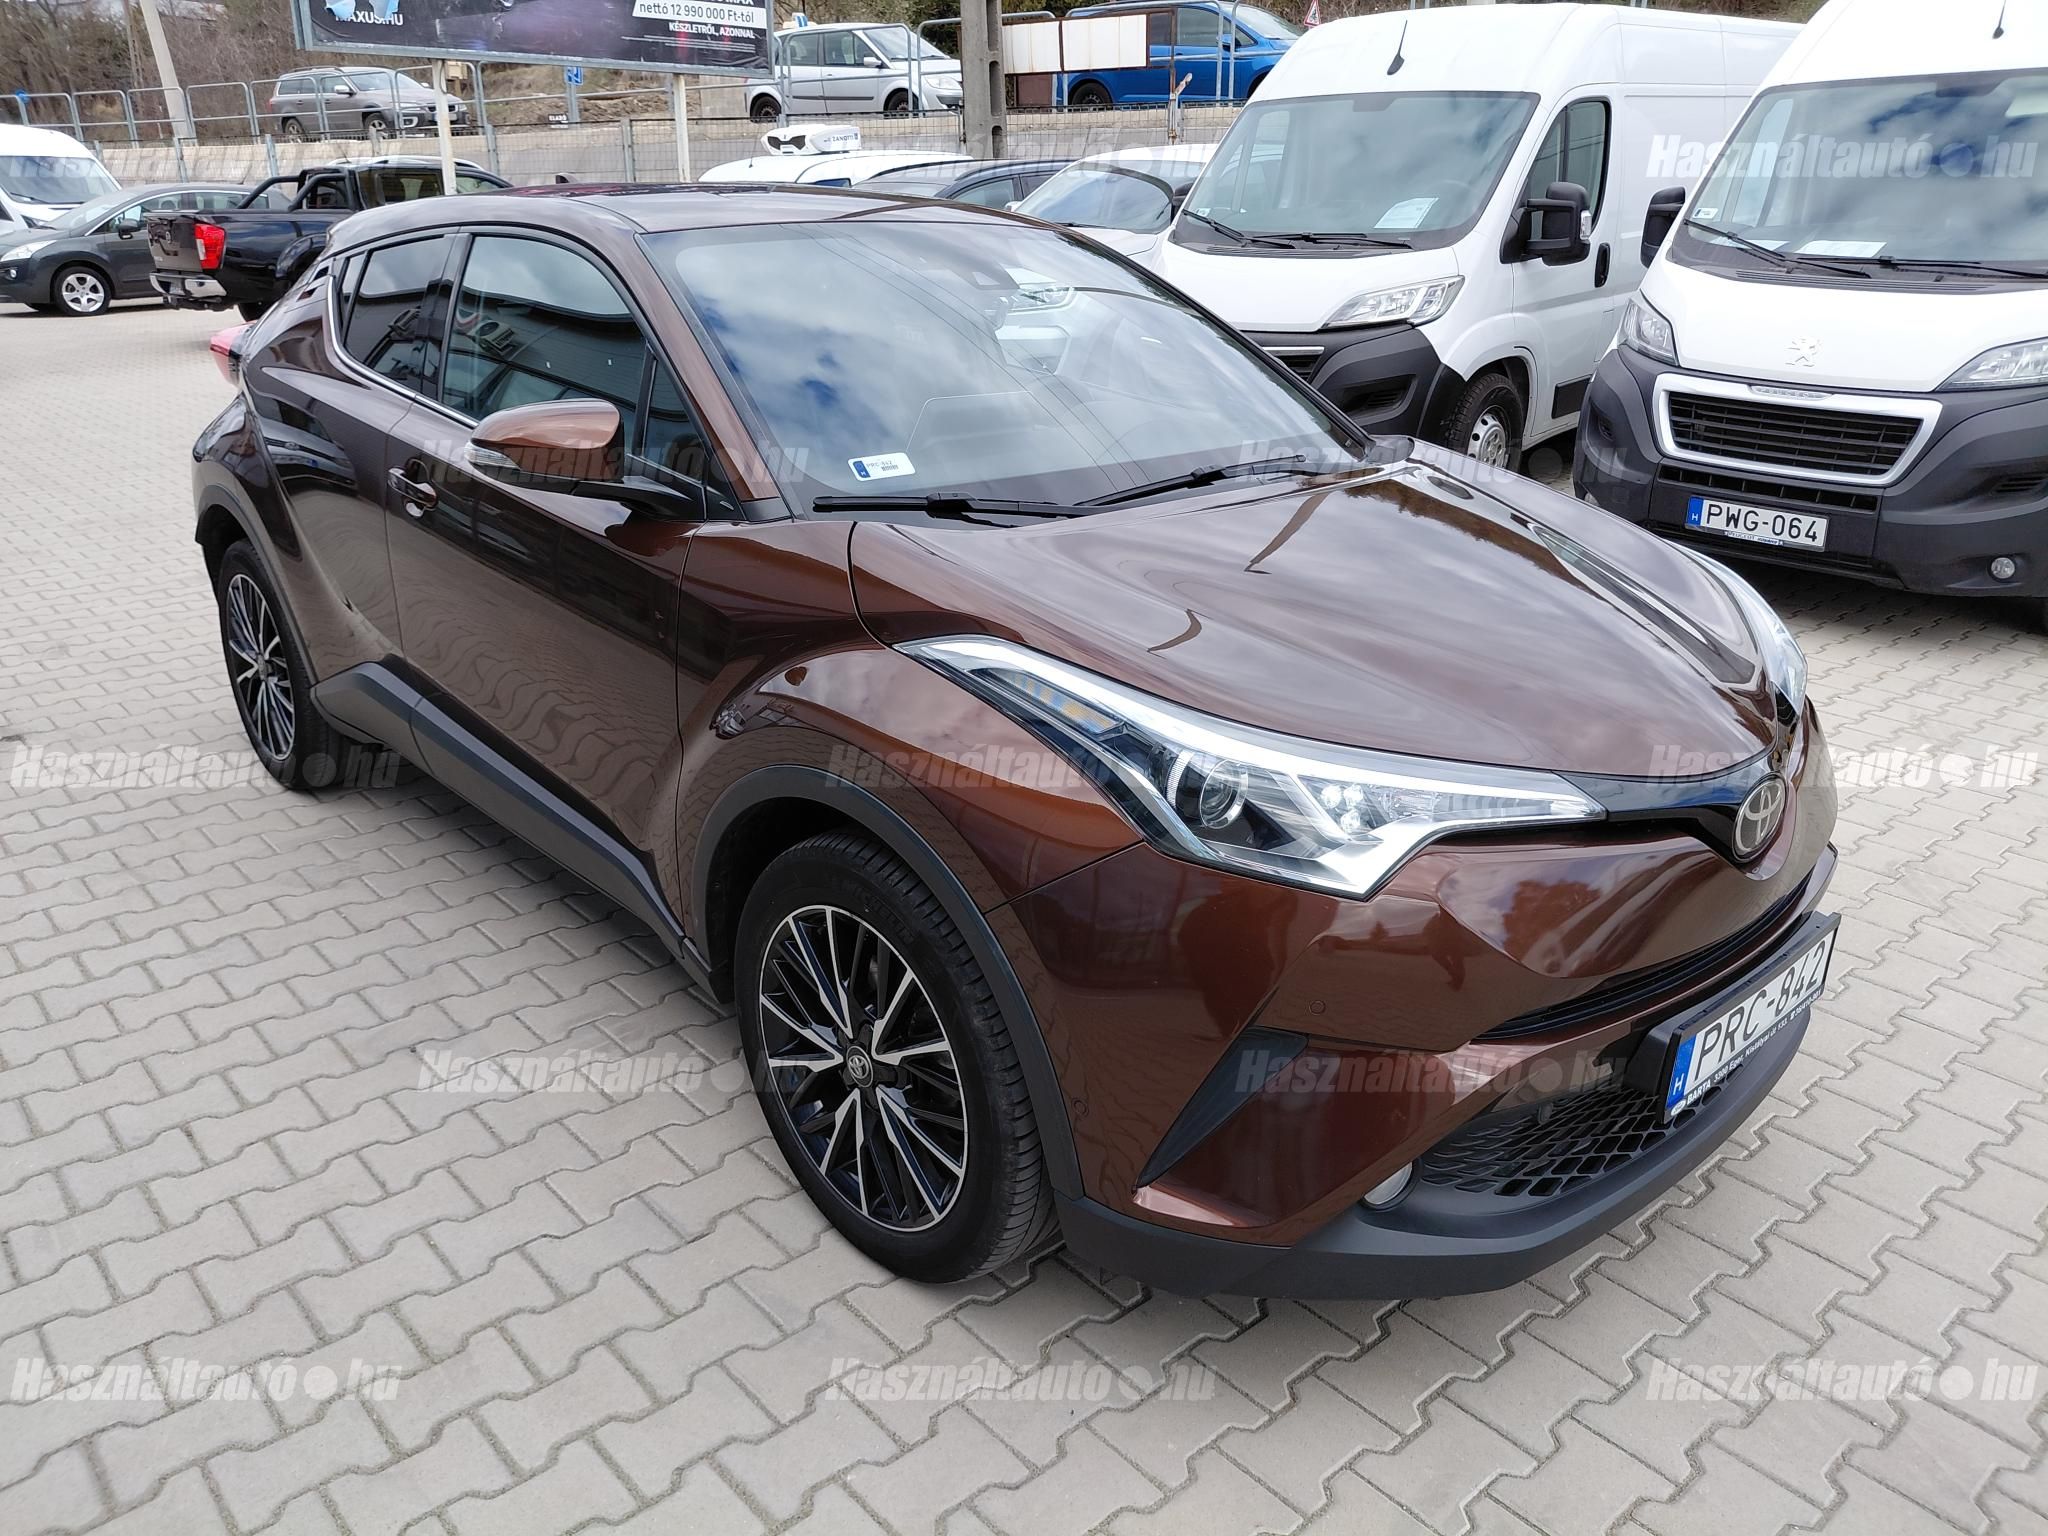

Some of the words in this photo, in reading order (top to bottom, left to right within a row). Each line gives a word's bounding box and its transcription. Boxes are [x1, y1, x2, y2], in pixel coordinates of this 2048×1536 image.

[640, 3, 668, 14] nettó
[671, 4, 681, 15] 12
[684, 5, 703, 17] 990
[706, 7, 725, 19] 000
[728, 10, 754, 23] Ft-tól
[720, 26, 755, 39] AZONNAL
[1691, 512, 1698, 521] H
[1706, 503, 1817, 542] PWG-064
[1672, 1073, 1685, 1095] H
[1694, 939, 1826, 1082] PRC-842
[1687, 1079, 1711, 1105] BARTA
